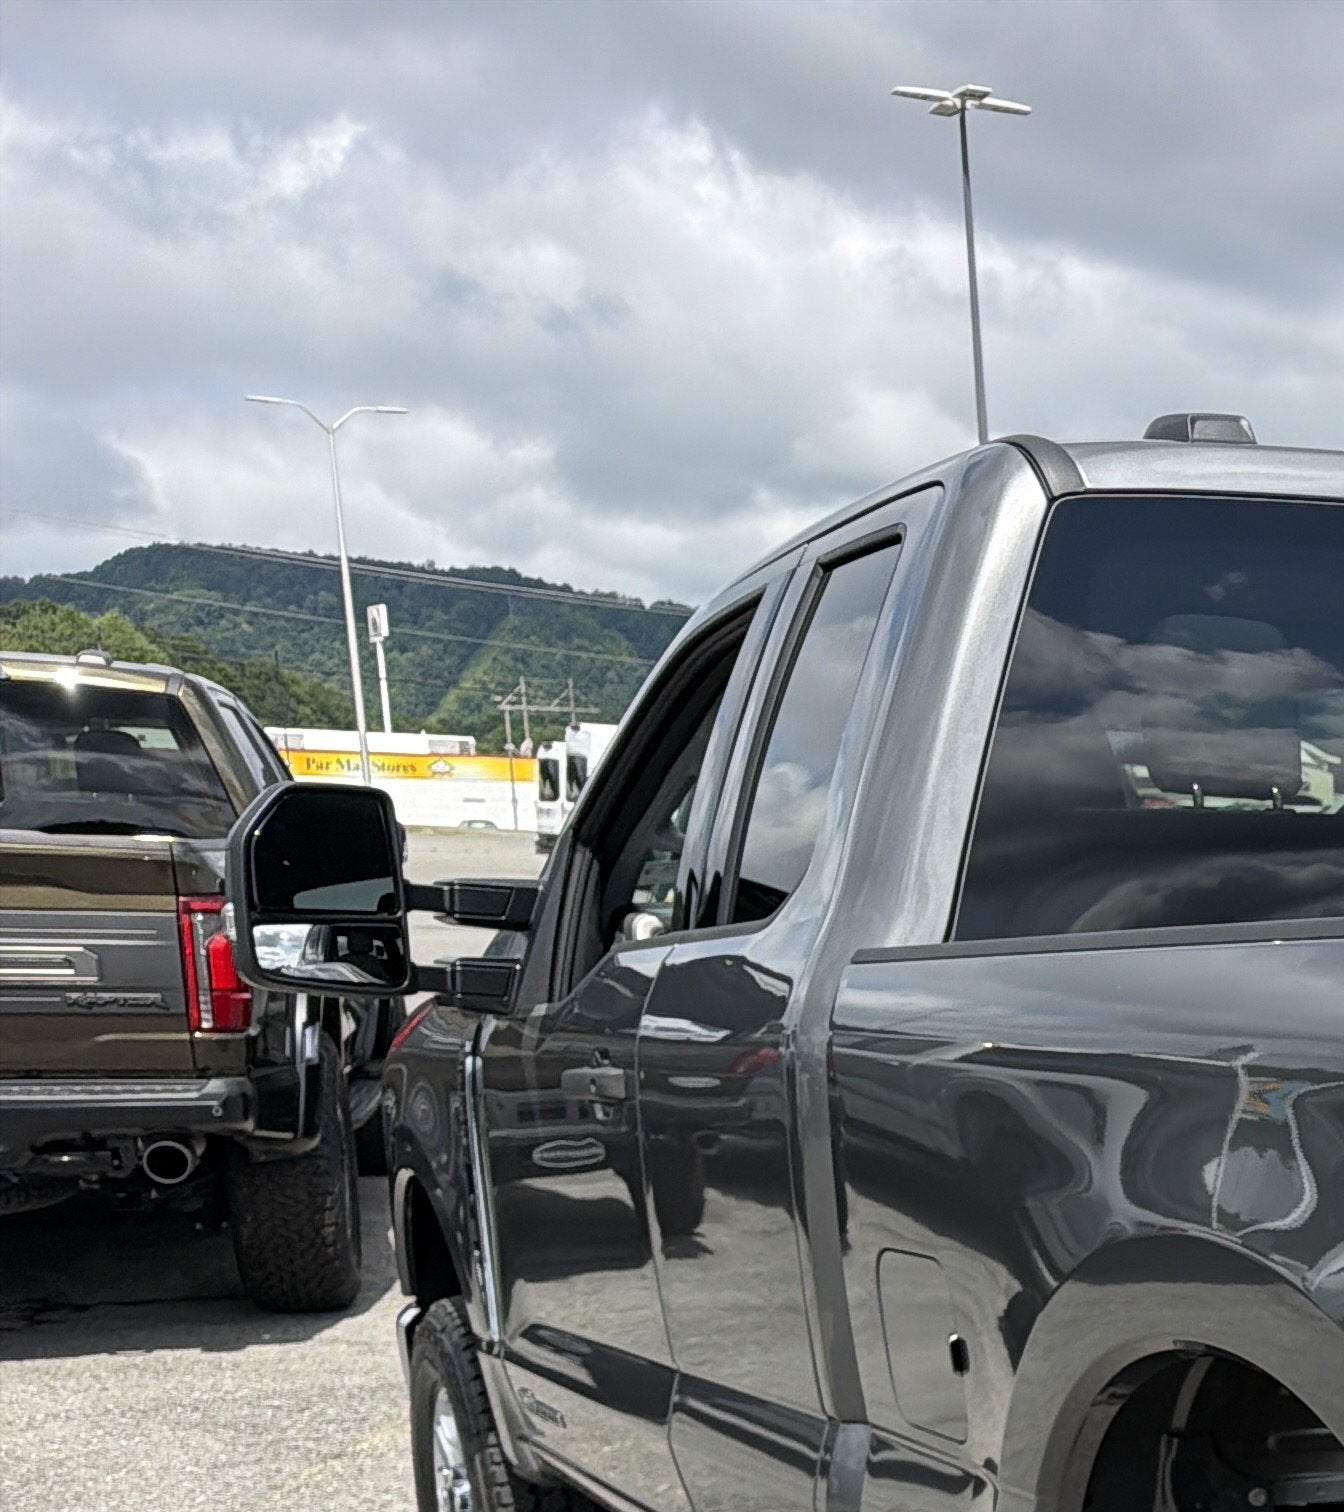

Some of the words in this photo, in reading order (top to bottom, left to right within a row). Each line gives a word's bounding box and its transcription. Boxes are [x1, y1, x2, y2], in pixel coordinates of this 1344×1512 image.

[305, 756, 332, 771] Par
[335, 757, 362, 772] Ma
[371, 758, 418, 774] Stores
